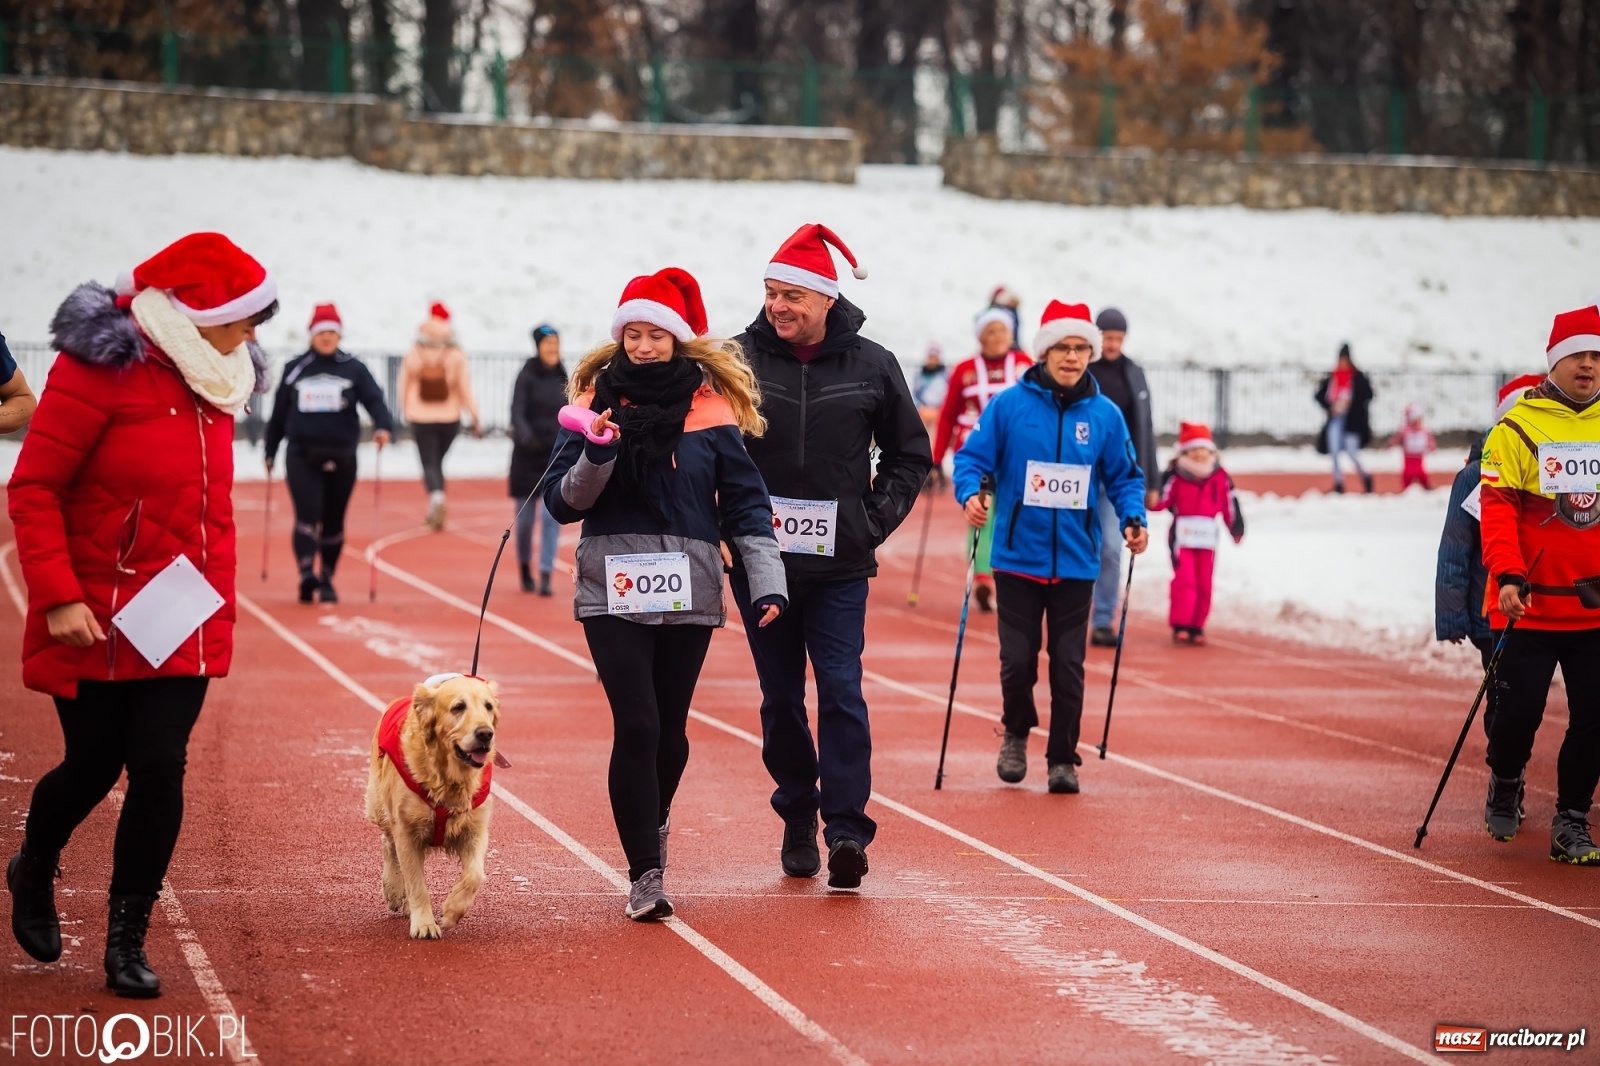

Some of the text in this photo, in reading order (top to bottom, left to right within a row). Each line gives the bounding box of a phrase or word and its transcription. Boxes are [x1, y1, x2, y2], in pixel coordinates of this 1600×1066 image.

[1565, 459, 1600, 476] 010
[1048, 478, 1080, 494] 061
[1574, 512, 1590, 523] OCR
[784, 517, 828, 537] 025
[636, 573, 683, 594] 020
